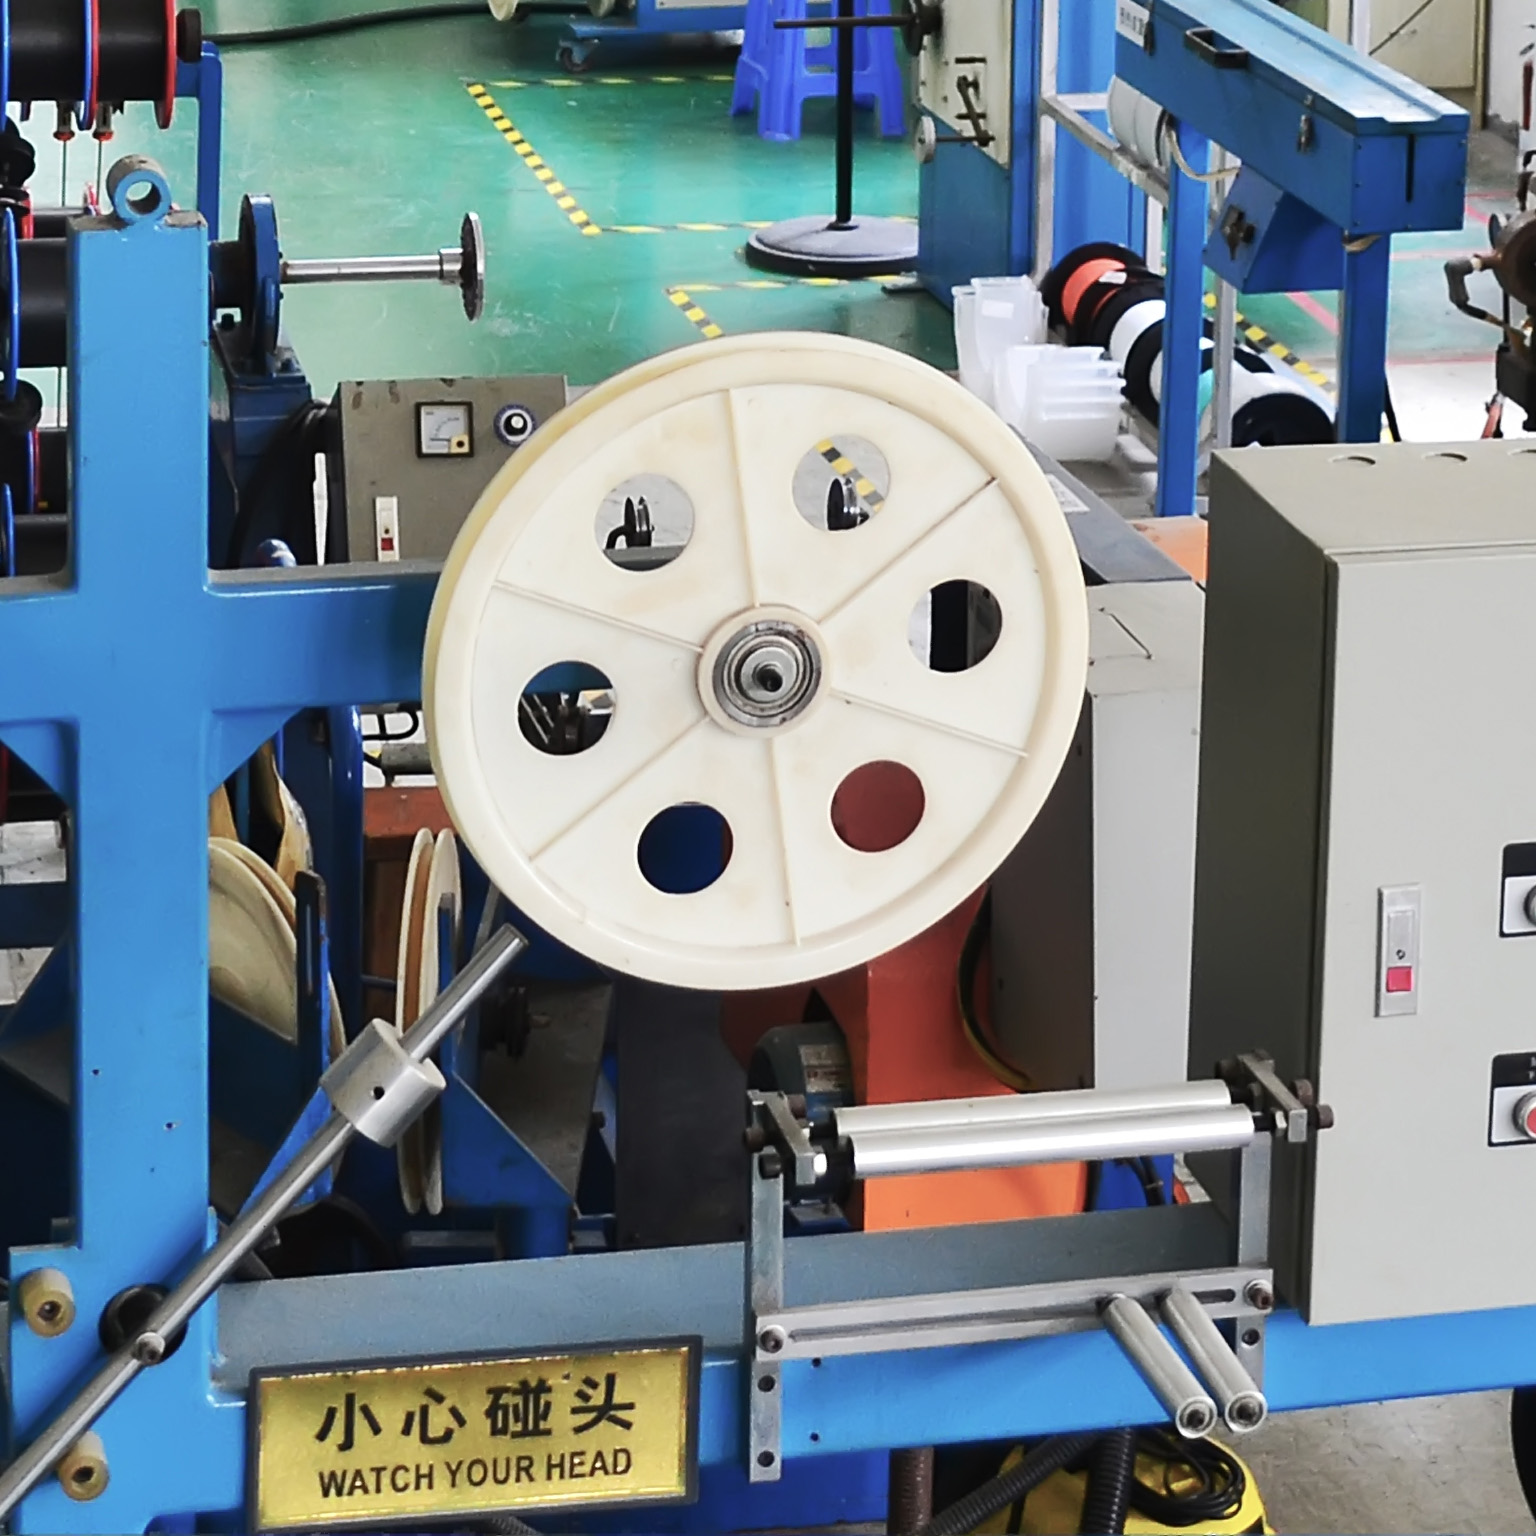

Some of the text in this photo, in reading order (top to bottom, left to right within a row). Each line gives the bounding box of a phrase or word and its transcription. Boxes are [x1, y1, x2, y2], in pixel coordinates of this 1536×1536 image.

[315, 1369, 636, 1453] 小心碰头
[318, 1445, 633, 1499] WATCH YOUR HEAD
